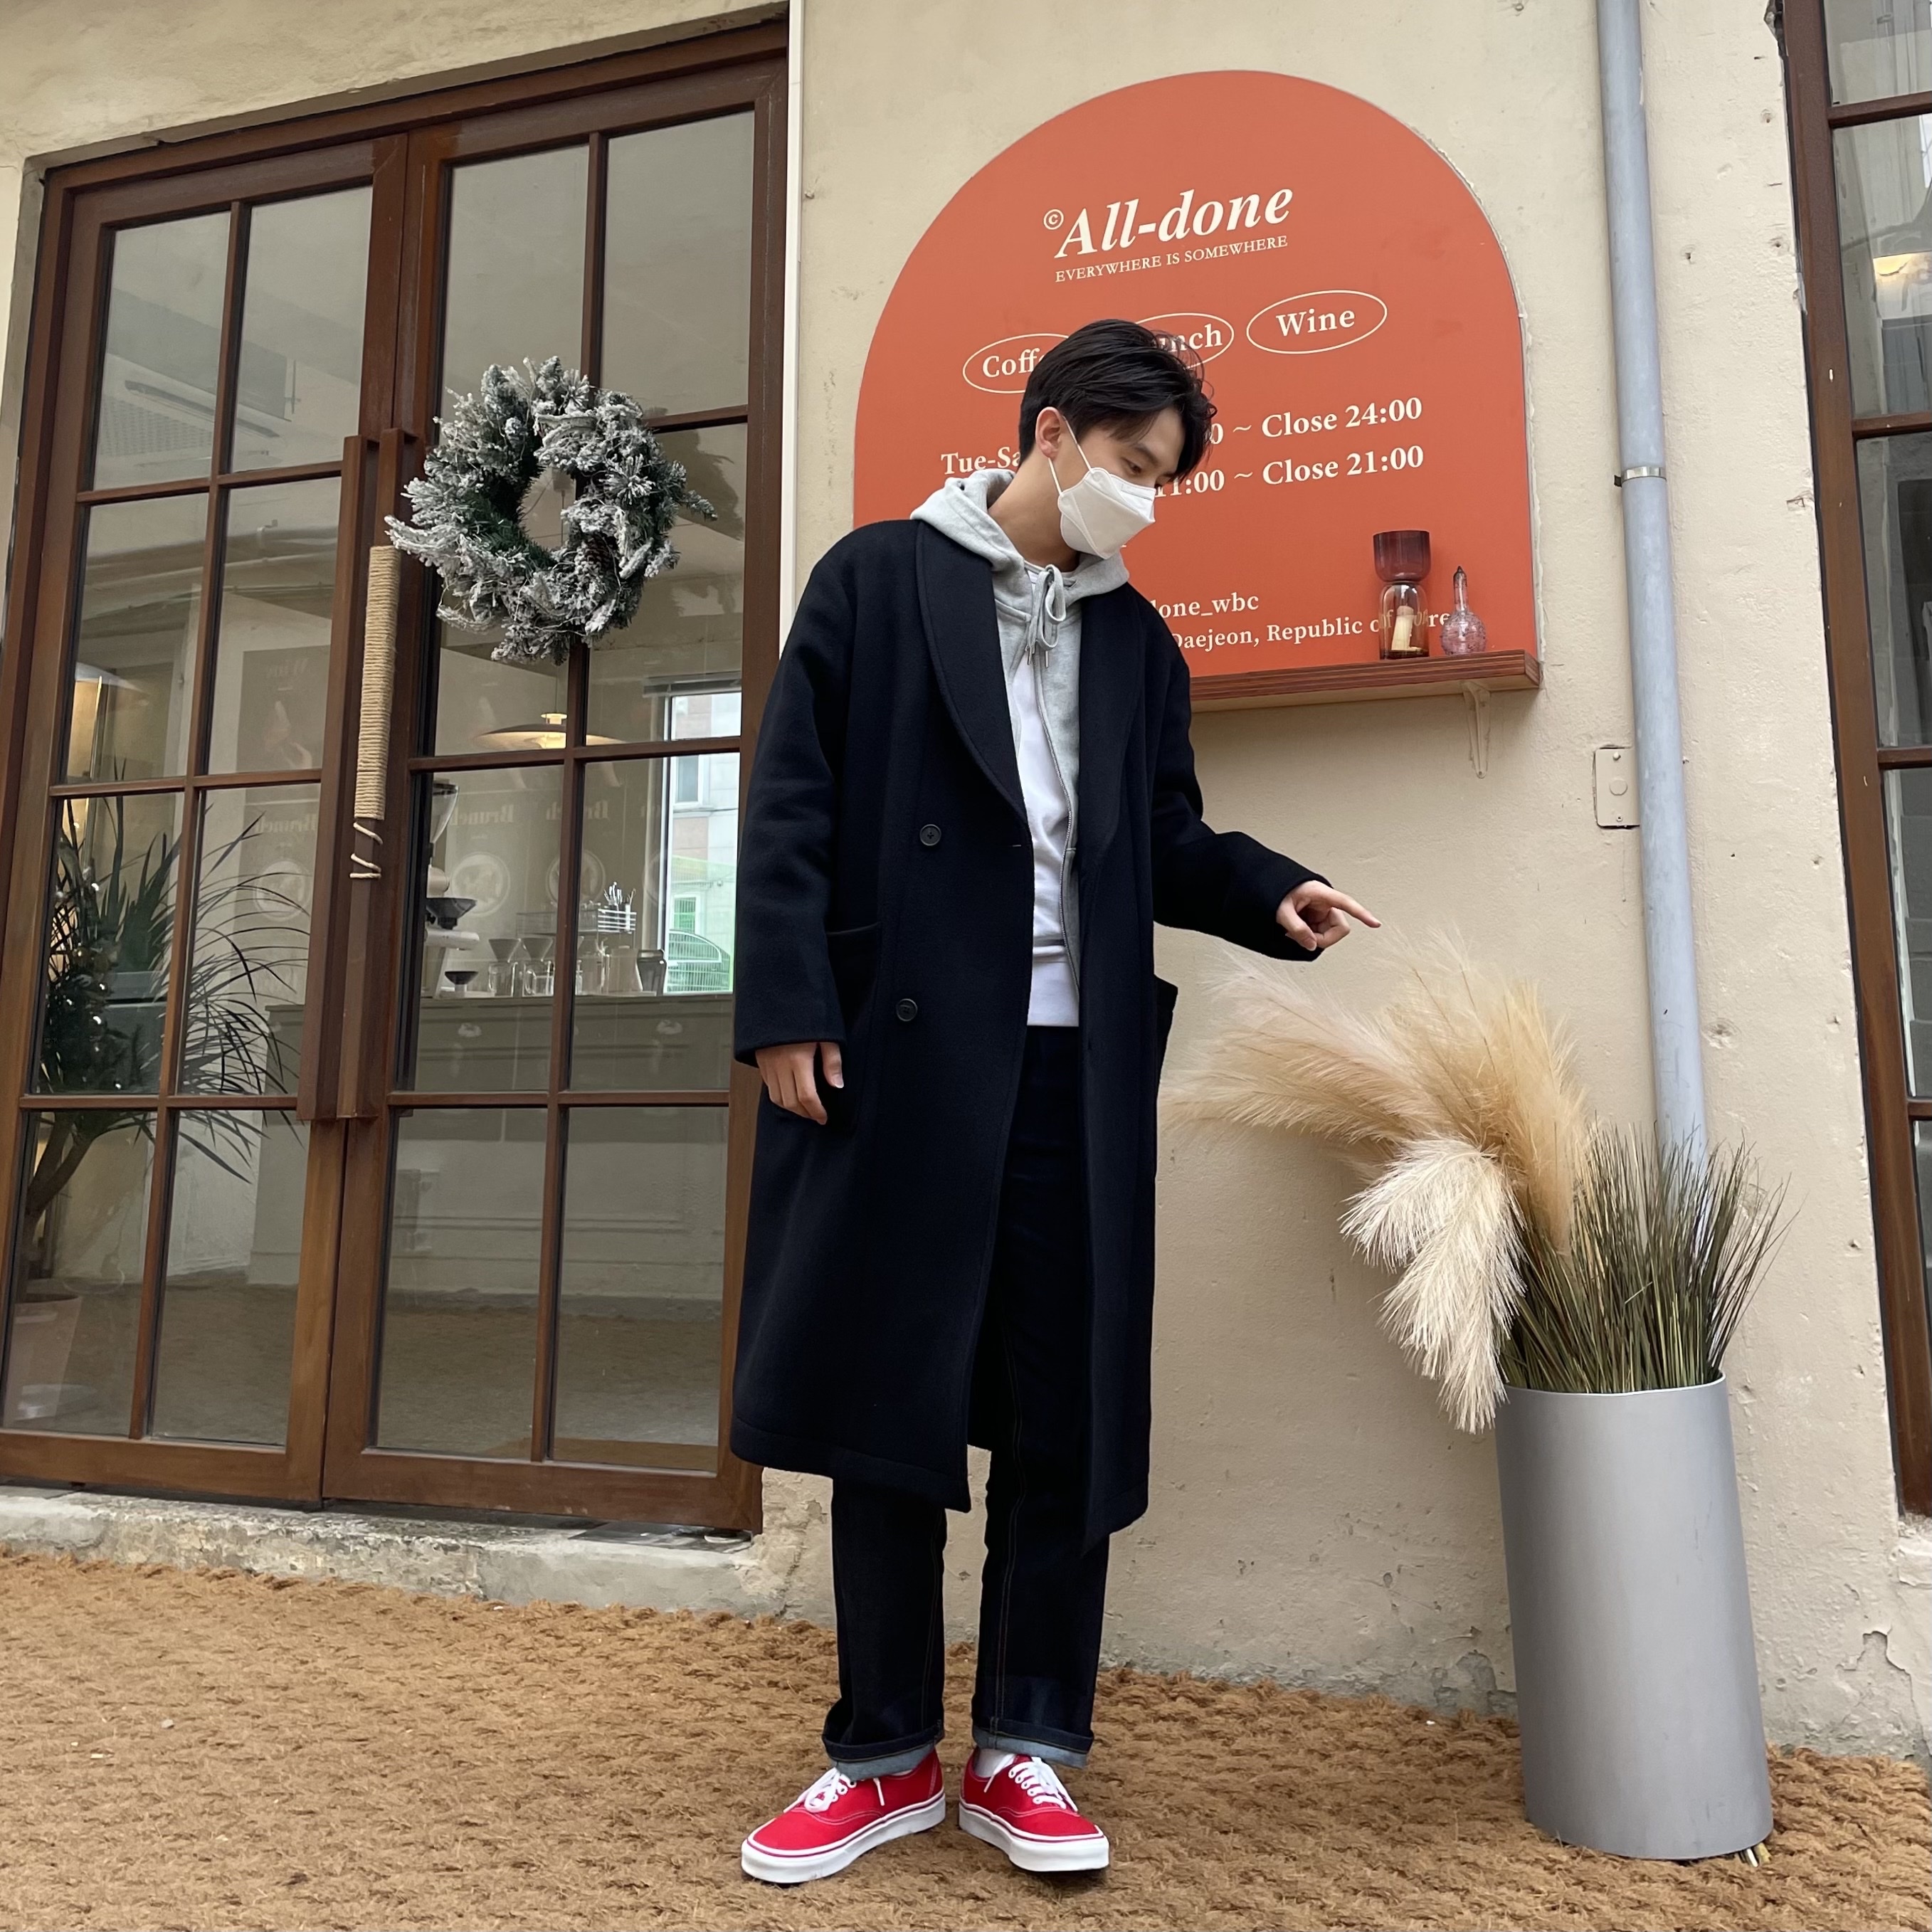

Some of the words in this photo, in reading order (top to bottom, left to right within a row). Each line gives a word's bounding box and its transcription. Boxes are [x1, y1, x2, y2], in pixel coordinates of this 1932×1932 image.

[1055, 255, 1162, 283] EVERYWHERE
[1166, 252, 1181, 266] IS
[1184, 235, 1289, 263] SOMEWHERE
[1157, 323, 1223, 352] nch
[1275, 308, 1356, 337] Wine
[982, 347, 1045, 378] Coff
[1262, 411, 1338, 438] Close
[1345, 397, 1422, 428] 24:00
[941, 446, 1020, 475] Tue-Sa
[1262, 459, 1339, 485] Close
[1346, 445, 1424, 476] 21:00
[1267, 616, 1363, 644] Republic
